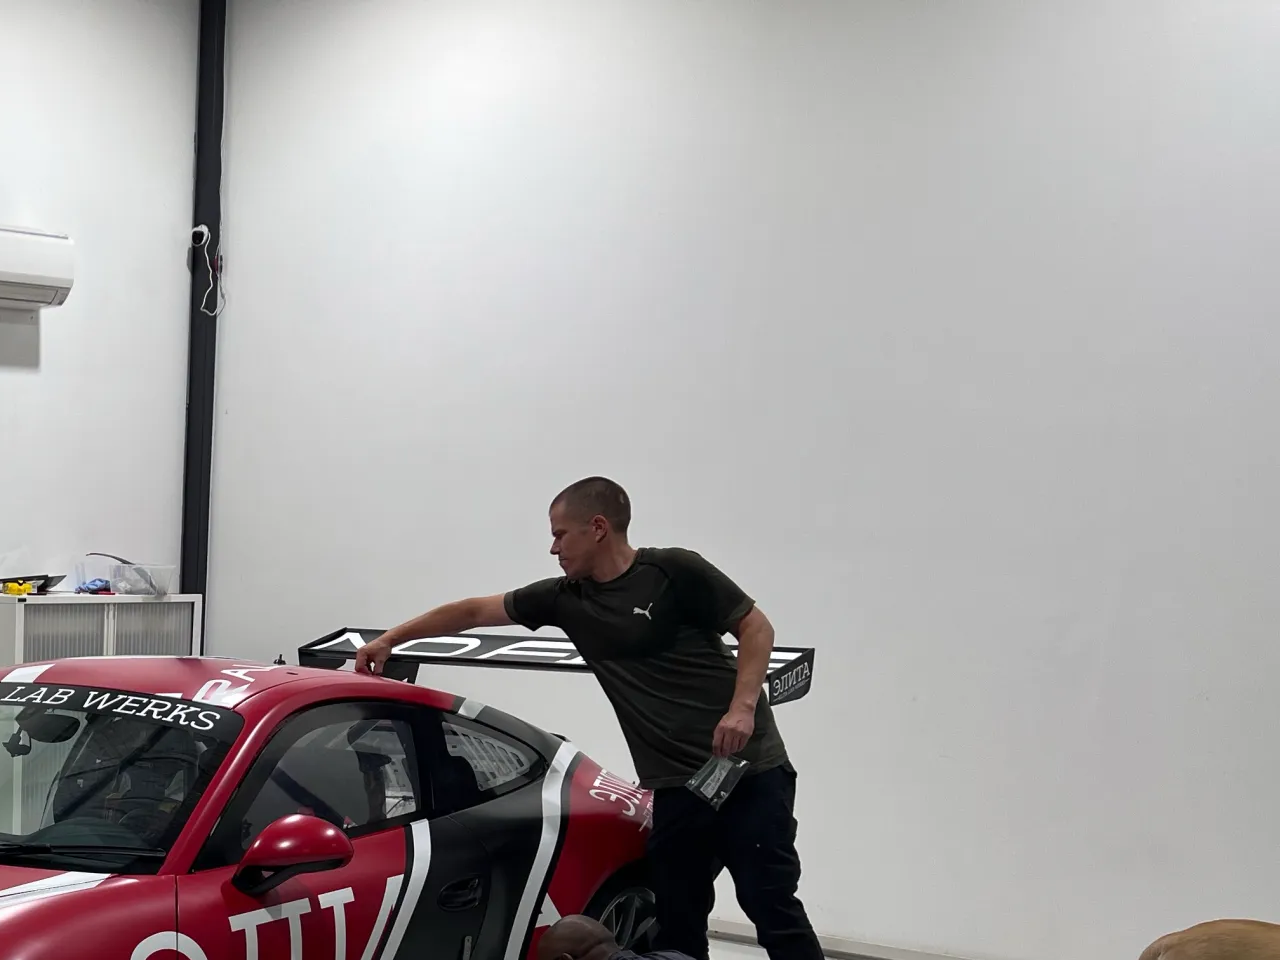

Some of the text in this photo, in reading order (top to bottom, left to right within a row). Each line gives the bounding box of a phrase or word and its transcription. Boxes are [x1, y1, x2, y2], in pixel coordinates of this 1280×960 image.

[773, 662, 810, 696] ЭЛИТА
[1, 686, 76, 705] LAB
[82, 691, 221, 730] WERKS
